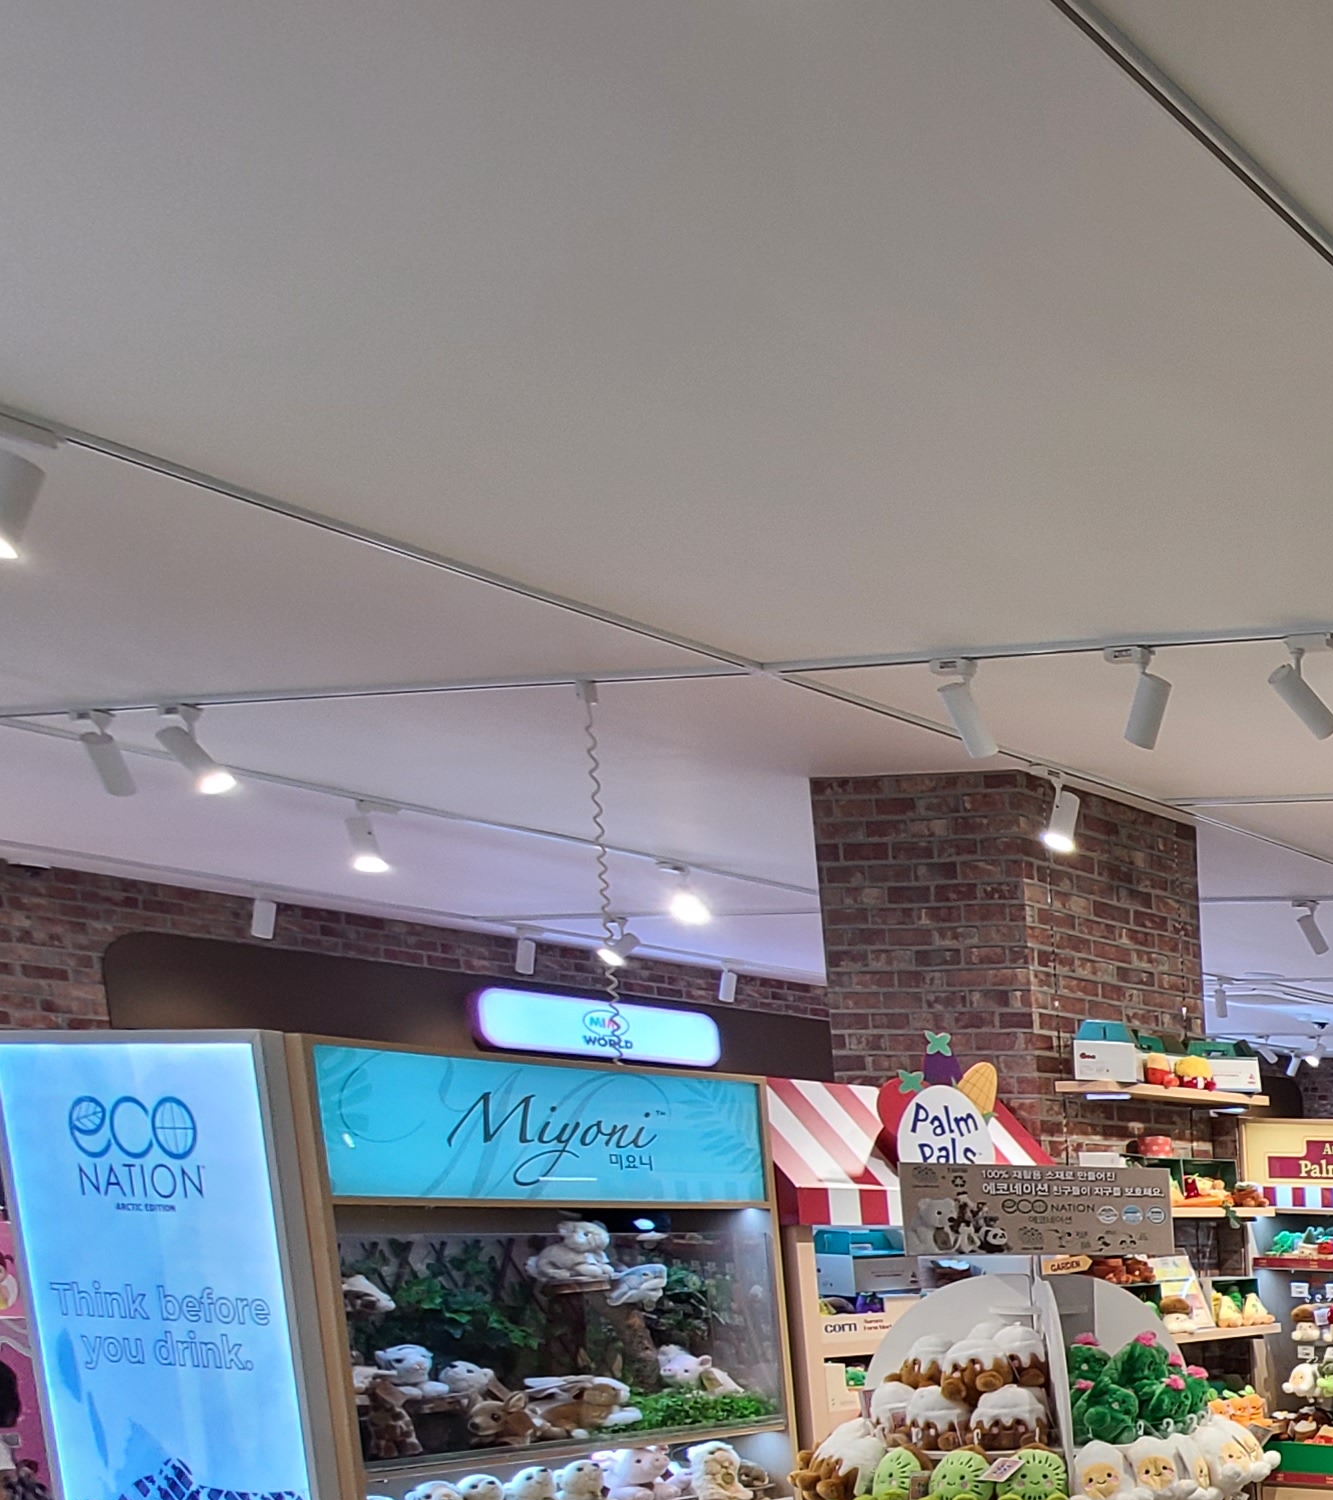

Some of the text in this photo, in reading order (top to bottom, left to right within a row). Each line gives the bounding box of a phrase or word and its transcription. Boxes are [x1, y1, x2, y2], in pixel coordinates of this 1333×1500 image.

[910, 1101, 978, 1138] Palm
[446, 1091, 658, 1187] Miyoni
[608, 1153, 654, 1171] 미요니
[77, 1162, 205, 1199] NATION
[981, 1169, 1009, 1180] 100%
[982, 1182, 1049, 1197] 에코네이션
[1050, 1203, 1096, 1214] NATION
[1050, 1259, 1081, 1272] GARDEN
[49, 1280, 271, 1327] Think before
[824, 1322, 858, 1334] corn
[81, 1330, 254, 1372] you drink.
